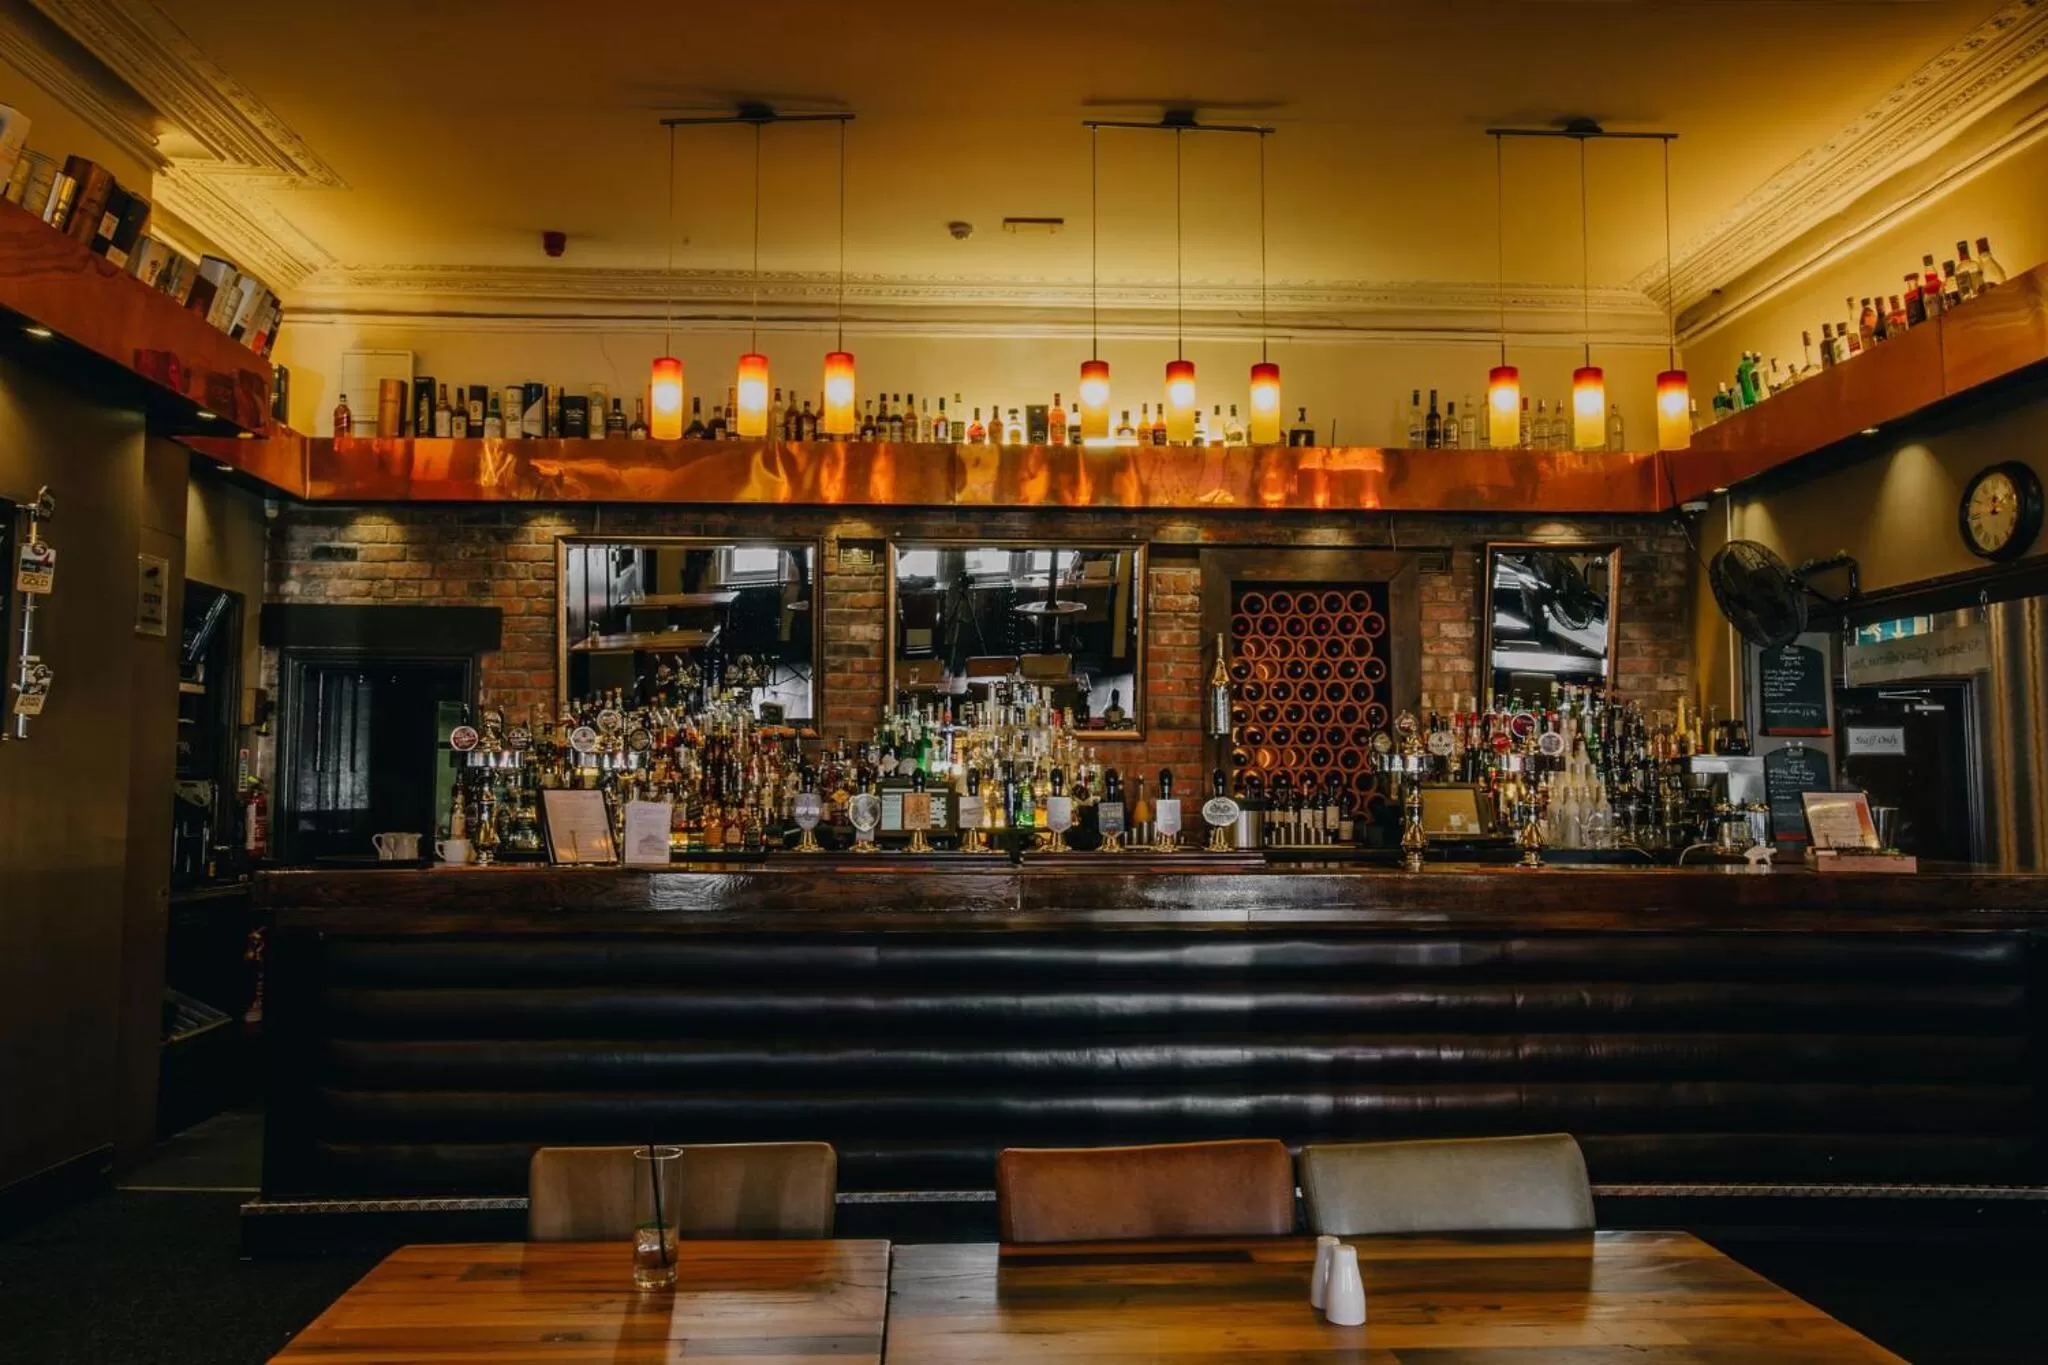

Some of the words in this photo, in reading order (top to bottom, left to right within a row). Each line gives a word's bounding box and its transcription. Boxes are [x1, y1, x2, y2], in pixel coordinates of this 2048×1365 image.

[21, 577, 48, 587] GOLD
[1854, 735, 1877, 746] Staff
[1878, 734, 1898, 746] Only
